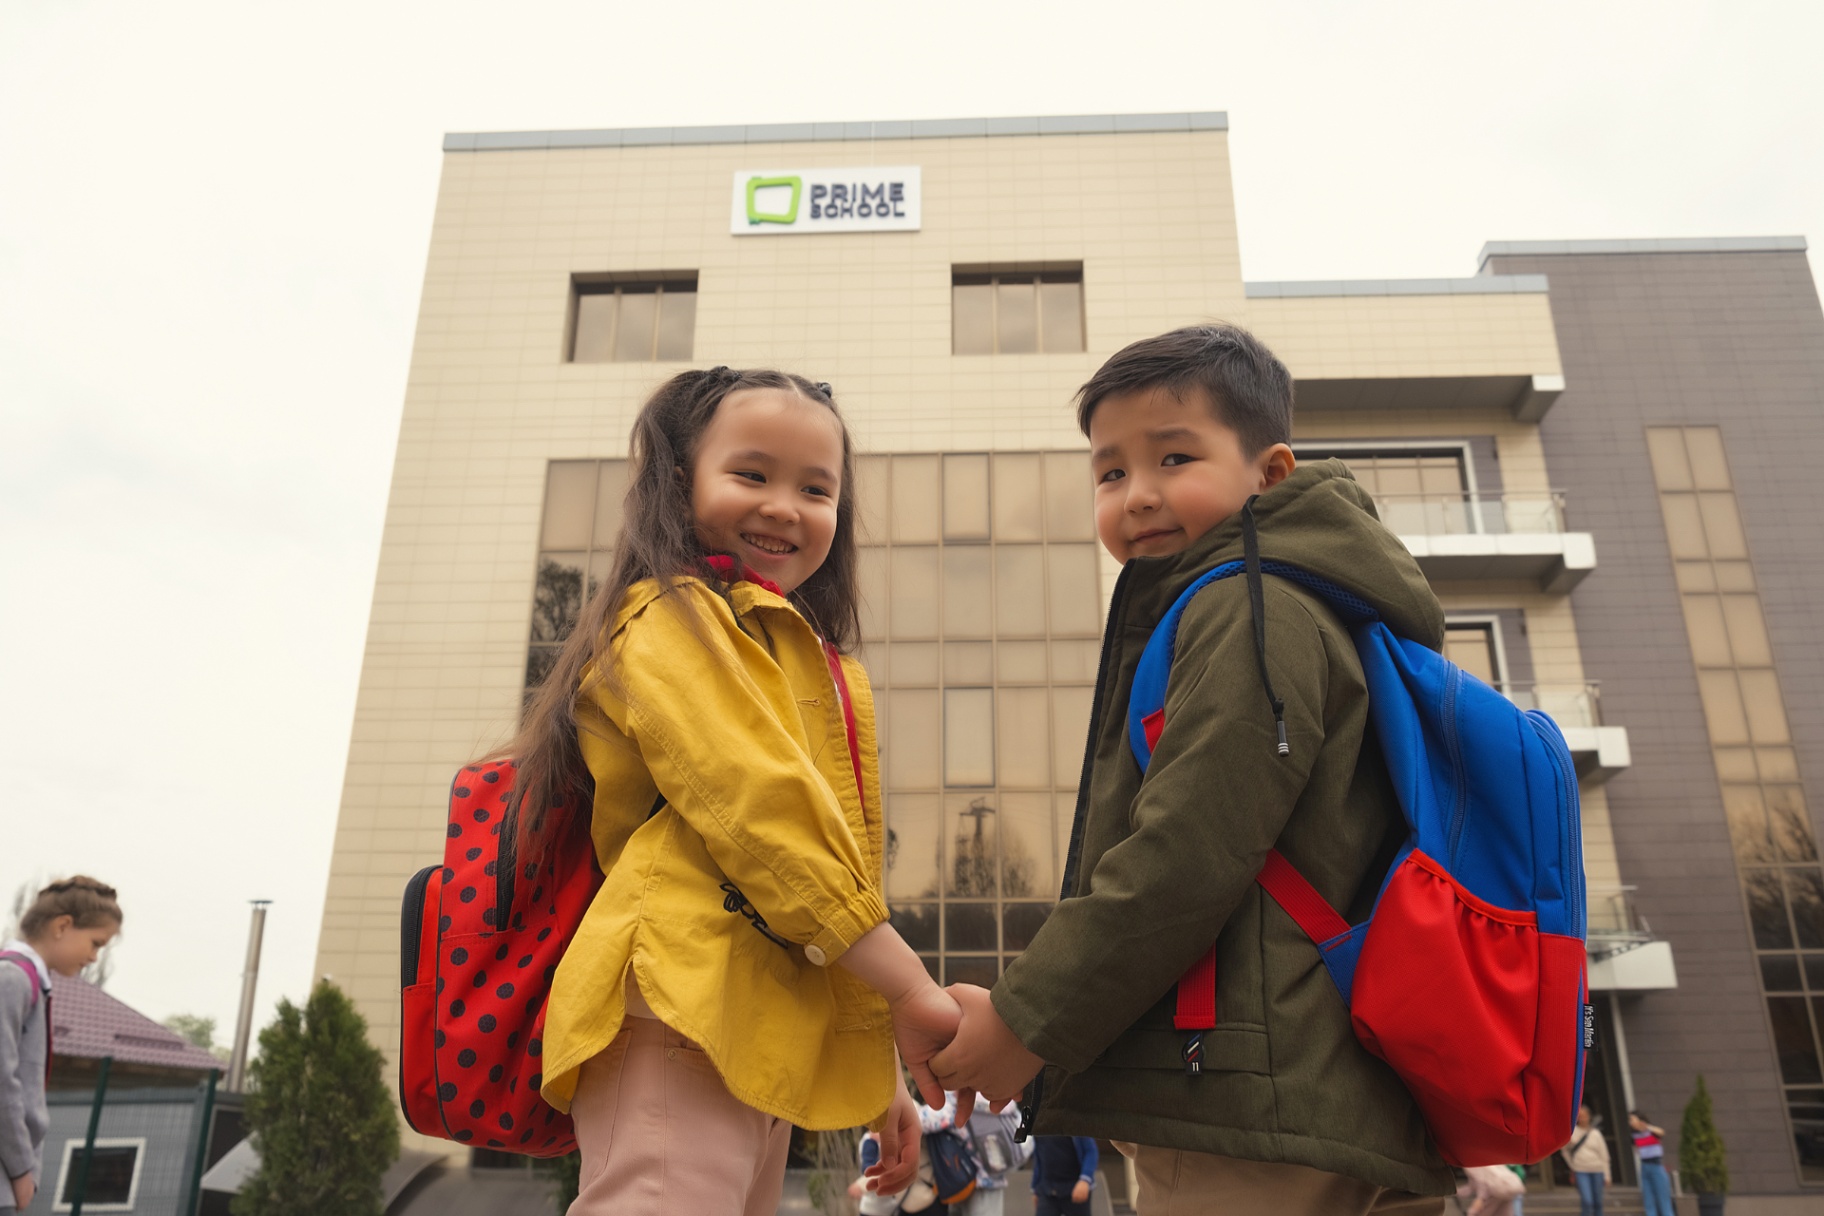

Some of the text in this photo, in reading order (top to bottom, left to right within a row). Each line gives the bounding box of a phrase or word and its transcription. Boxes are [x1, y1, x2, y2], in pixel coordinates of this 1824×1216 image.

[810, 183, 904, 203] PRIME
[810, 203, 905, 219] SCHOOL
[1584, 1015, 1594, 1028] San
